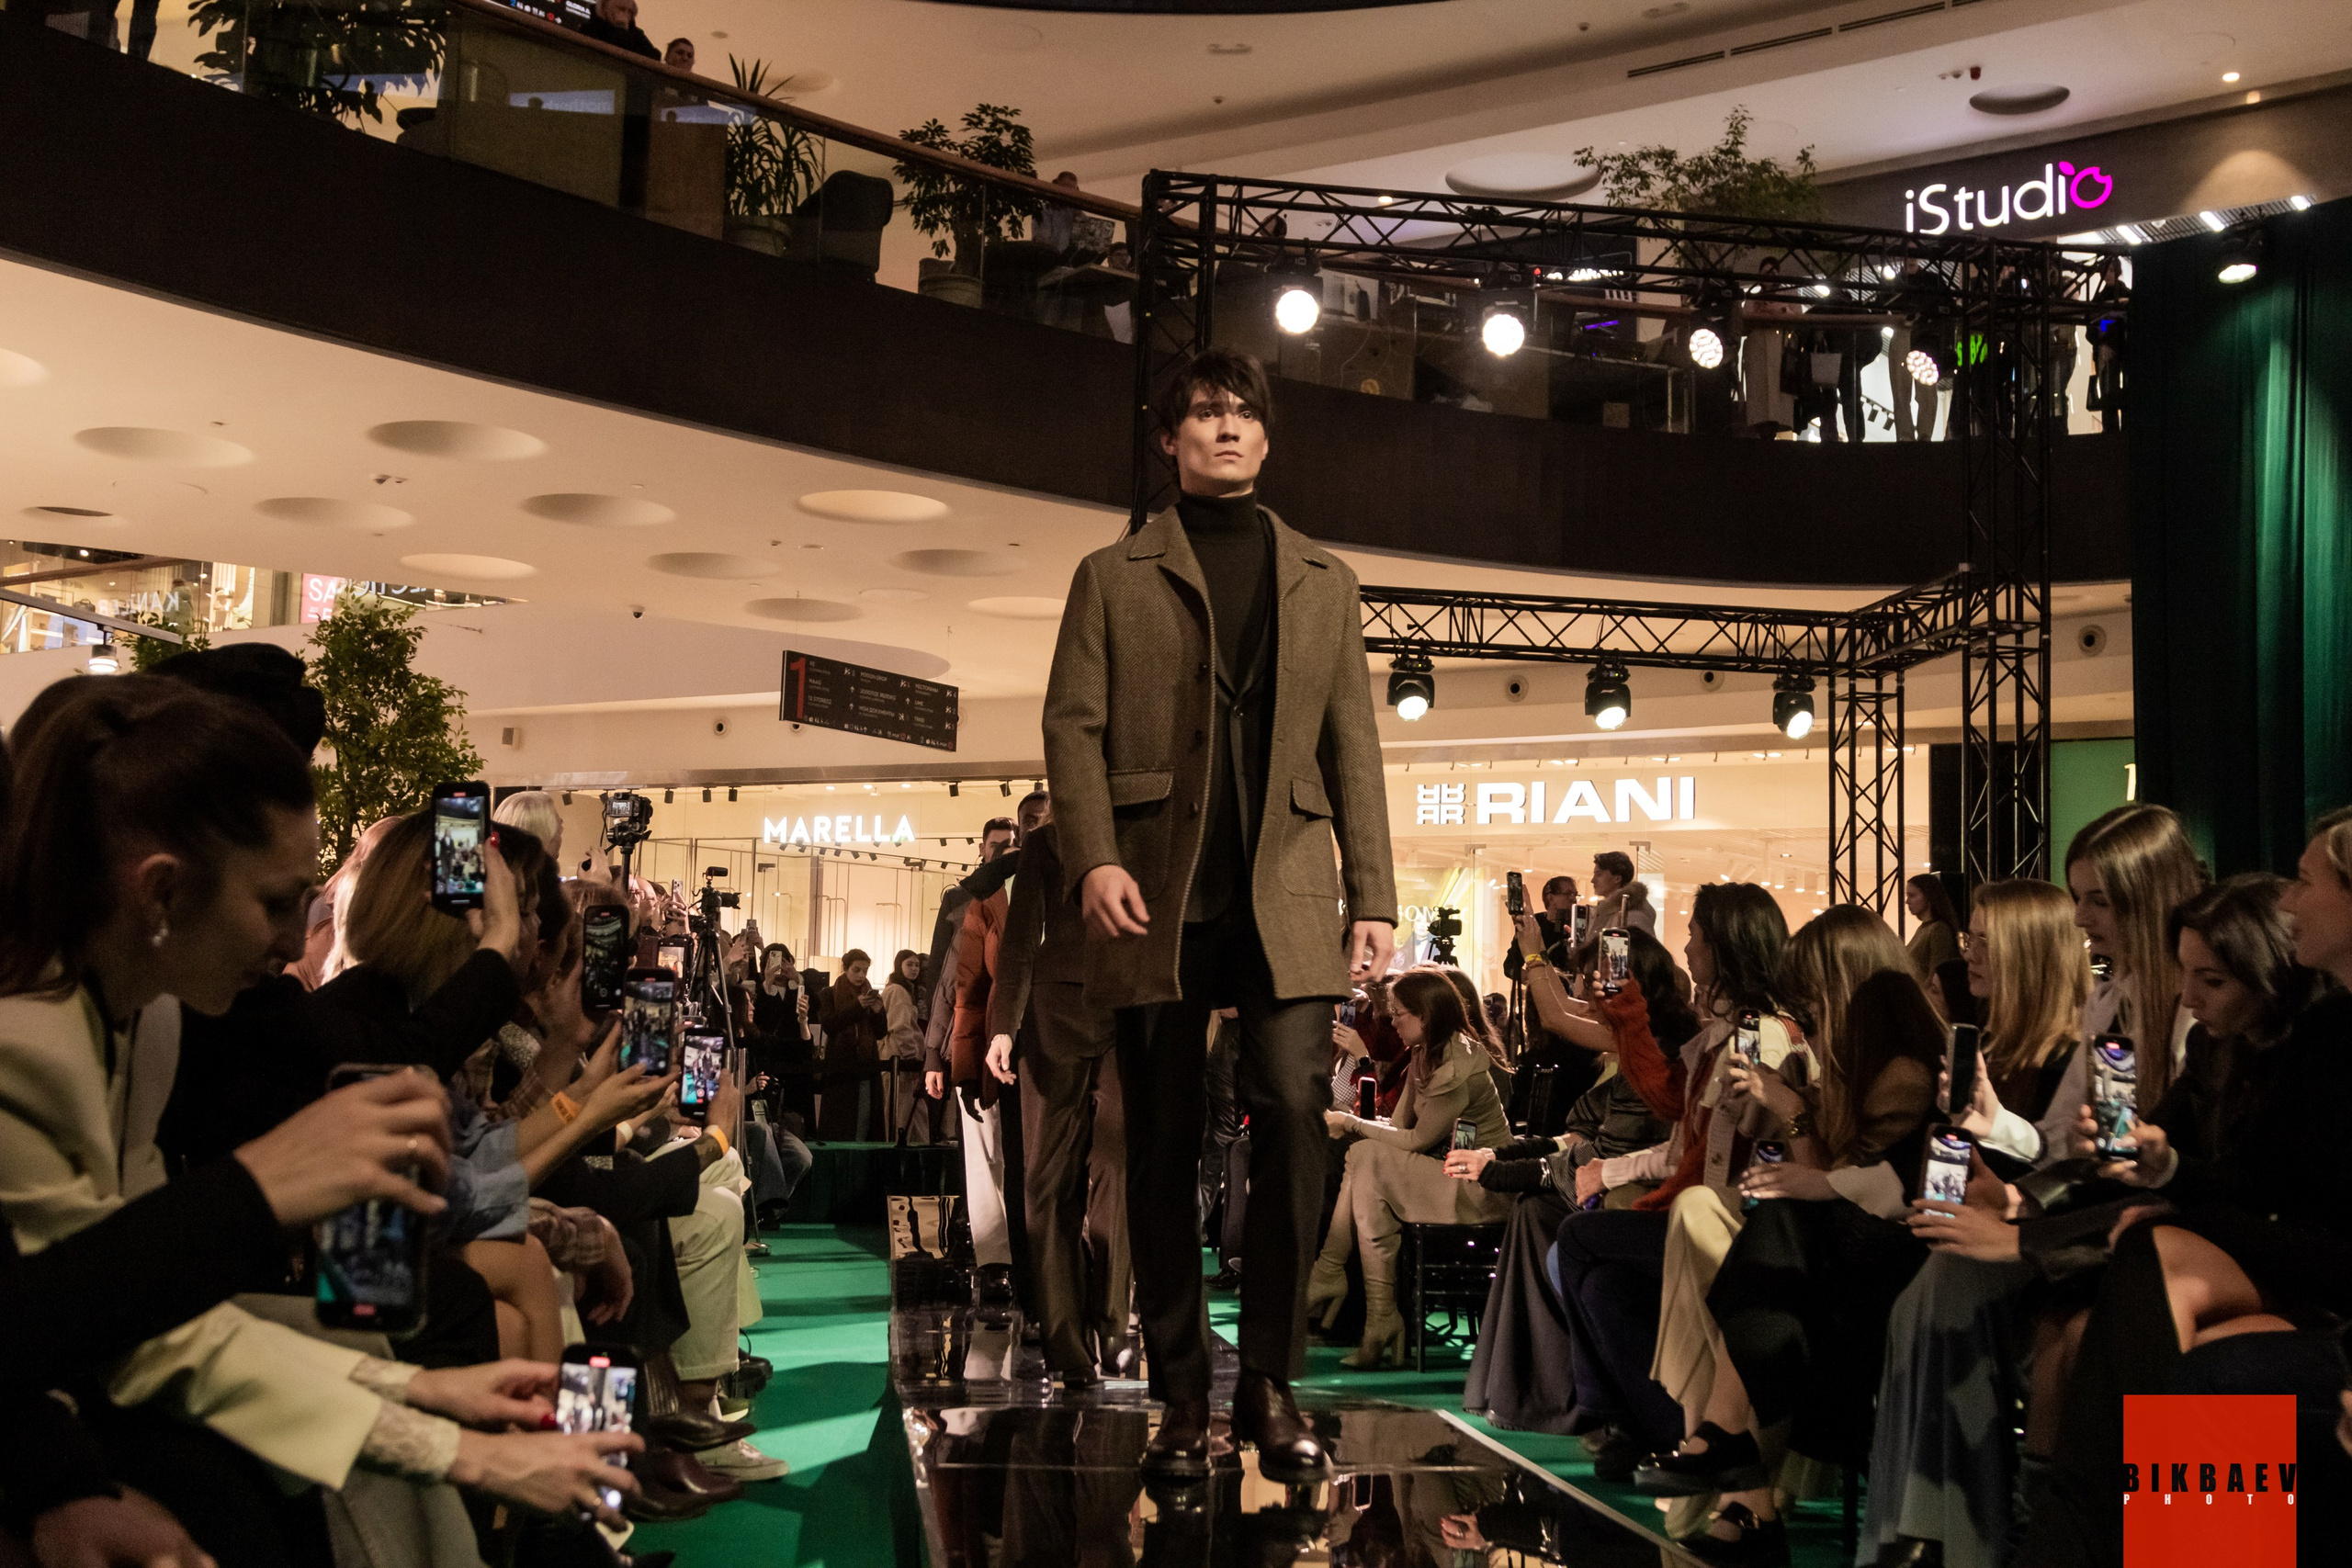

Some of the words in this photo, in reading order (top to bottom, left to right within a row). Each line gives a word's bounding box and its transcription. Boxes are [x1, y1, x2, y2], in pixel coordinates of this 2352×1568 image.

[1905, 161, 2113, 235] iStudio
[790, 657, 806, 719] 1
[1476, 776, 1695, 824] RIANI
[763, 814, 916, 844] MARELLA
